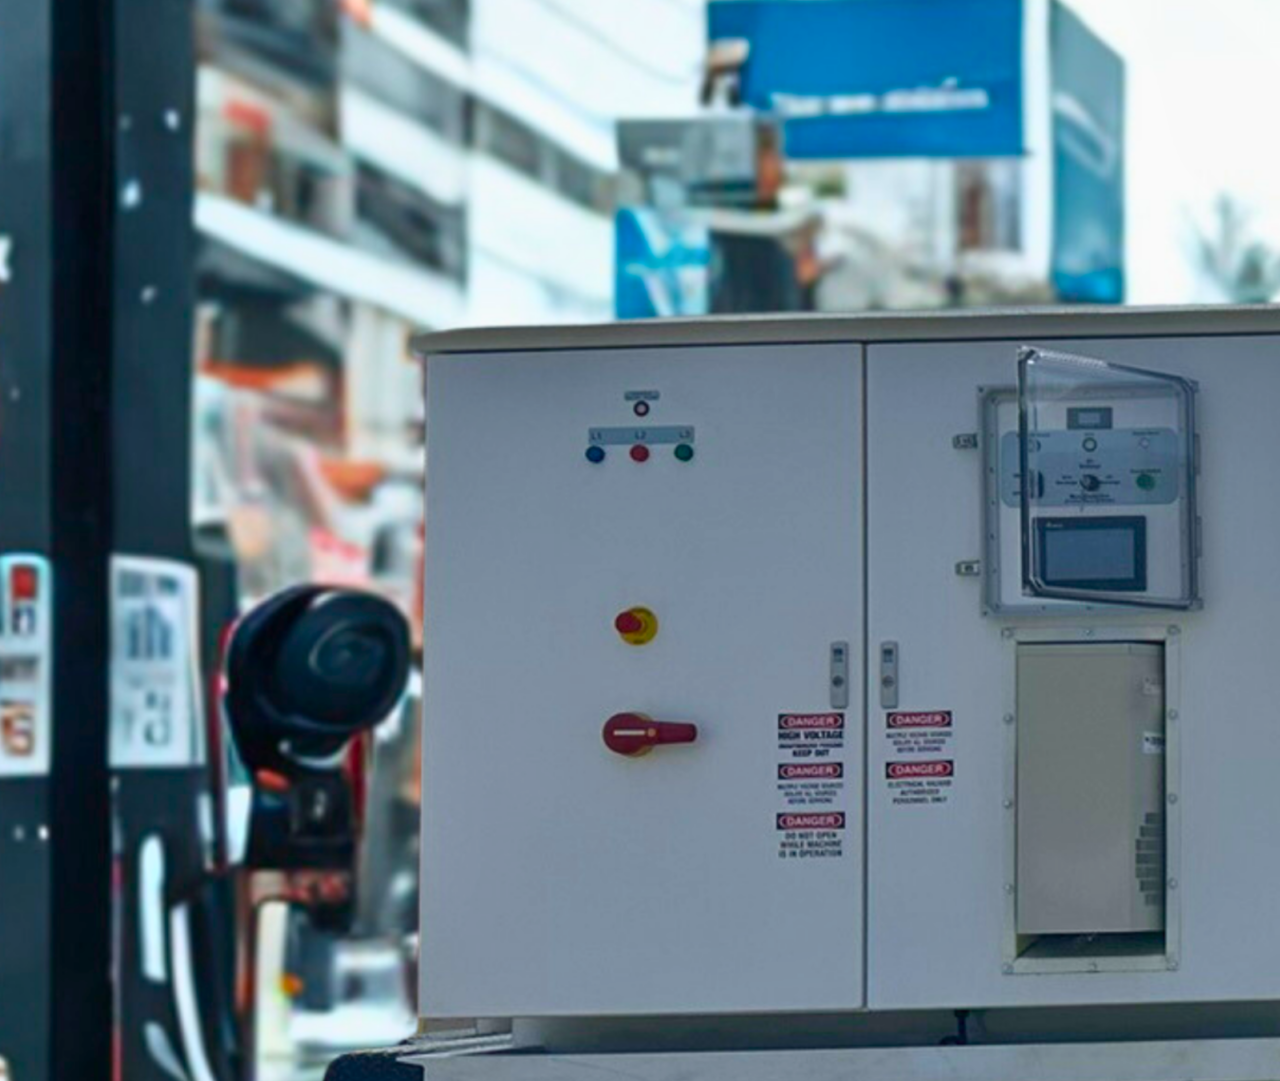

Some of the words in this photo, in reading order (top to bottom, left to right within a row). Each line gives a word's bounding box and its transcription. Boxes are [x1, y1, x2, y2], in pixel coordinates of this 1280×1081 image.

[634, 430, 647, 440] L2
[787, 716, 834, 727] DANGER
[896, 714, 943, 725] DANGER
[778, 731, 801, 740] HIGH
[804, 730, 844, 739] VOLTAGE
[792, 749, 812, 757] KEEP
[814, 749, 829, 757] OUT
[787, 766, 834, 776] DANGER
[896, 764, 943, 774] DANGER
[786, 815, 835, 826] DANGER
[785, 832, 796, 840] DO
[798, 832, 815, 840] NOT
[817, 831, 837, 839] OPEN
[780, 841, 804, 849] WHILE
[807, 840, 842, 848] MACHINE
[778, 850, 786, 858] IS
[799, 849, 842, 858] OPERATION
